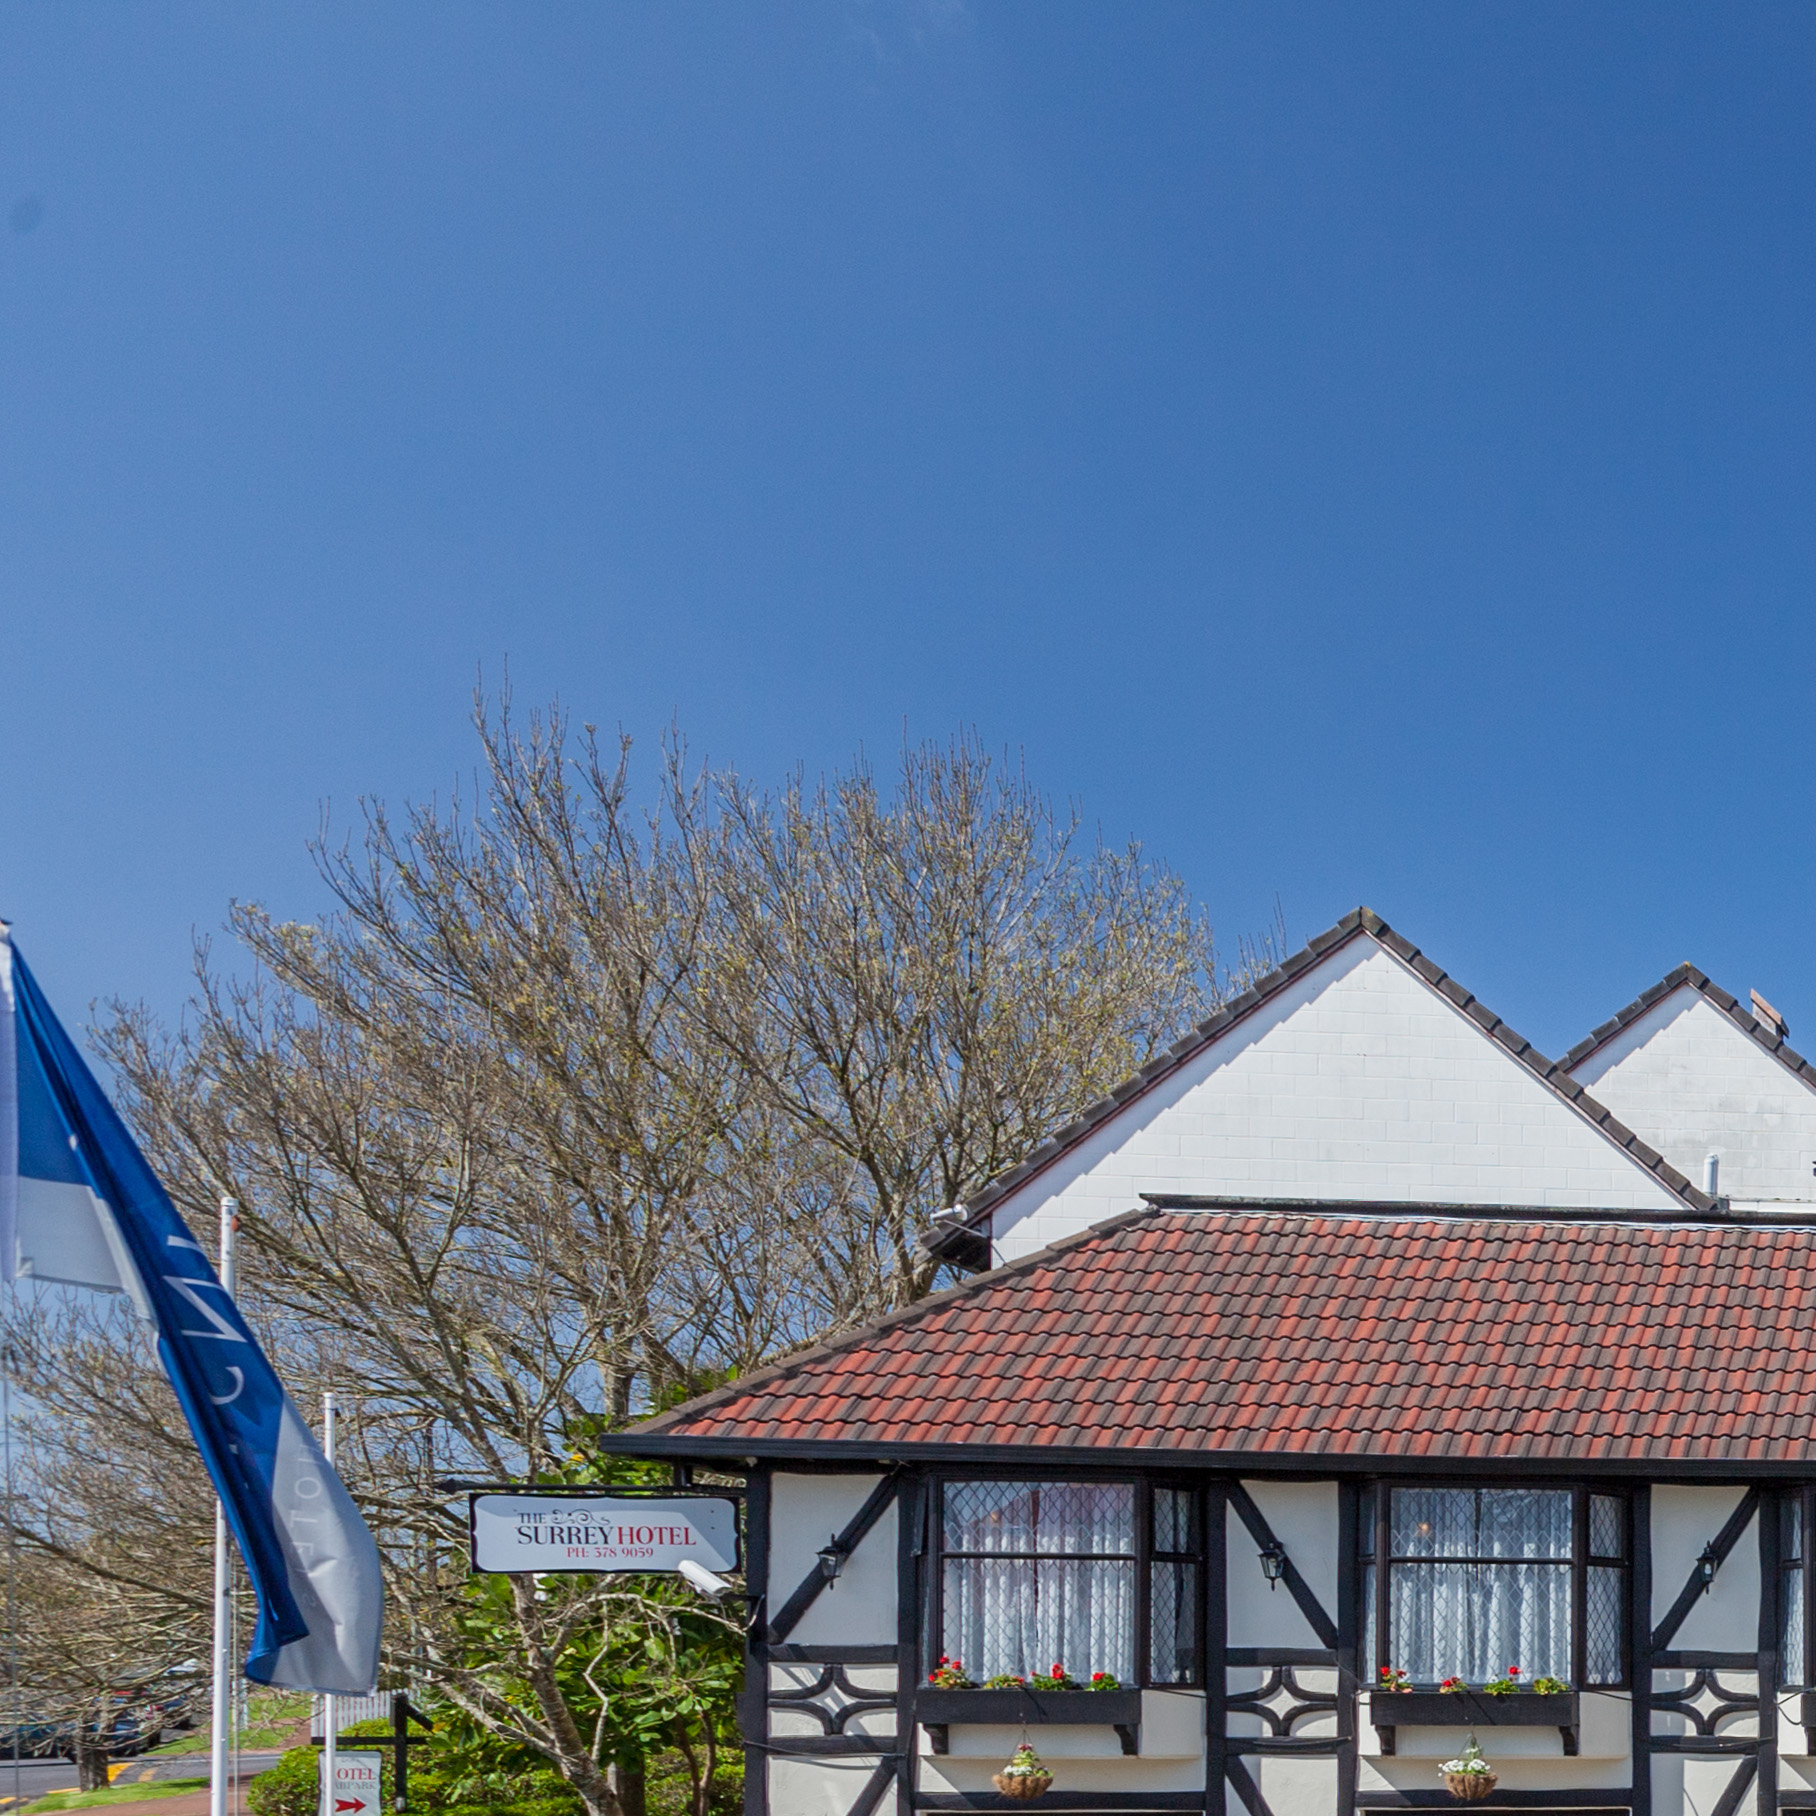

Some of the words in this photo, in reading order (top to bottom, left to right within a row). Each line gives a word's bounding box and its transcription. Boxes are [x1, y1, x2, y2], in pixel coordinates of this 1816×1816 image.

[517, 1512, 546, 1524] THE
[517, 1526, 613, 1545] SURREY
[617, 1526, 697, 1546] HOTEL
[567, 1547, 590, 1558] PH:
[594, 1547, 617, 1558] 378
[621, 1547, 653, 1558] 9059
[335, 1767, 376, 1780] OTEL
